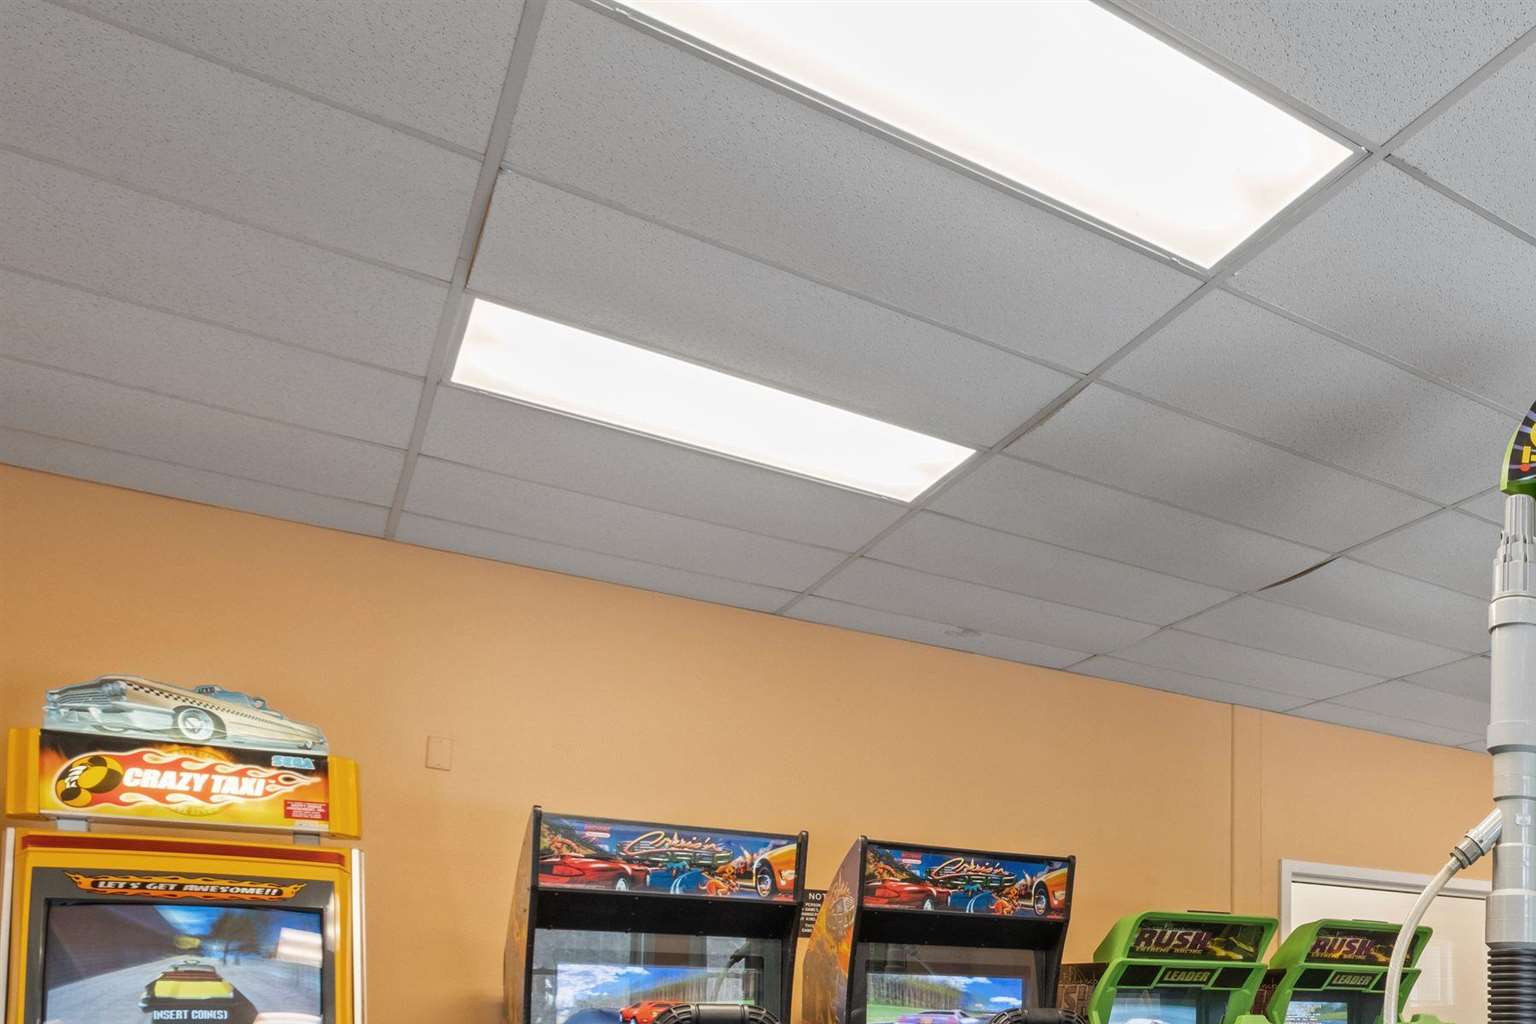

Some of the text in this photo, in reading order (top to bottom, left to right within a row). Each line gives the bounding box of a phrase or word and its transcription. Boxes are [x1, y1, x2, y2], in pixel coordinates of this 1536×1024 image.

[271, 755, 316, 770] SEGA
[122, 767, 266, 797] CRAZY TAXI
[98, 880, 140, 889] LET'S
[145, 882, 178, 891] GET
[1163, 970, 1210, 982] LEADER
[1332, 975, 1372, 985] LEADER
[153, 1009, 228, 1020] INSERT COIN(S)
